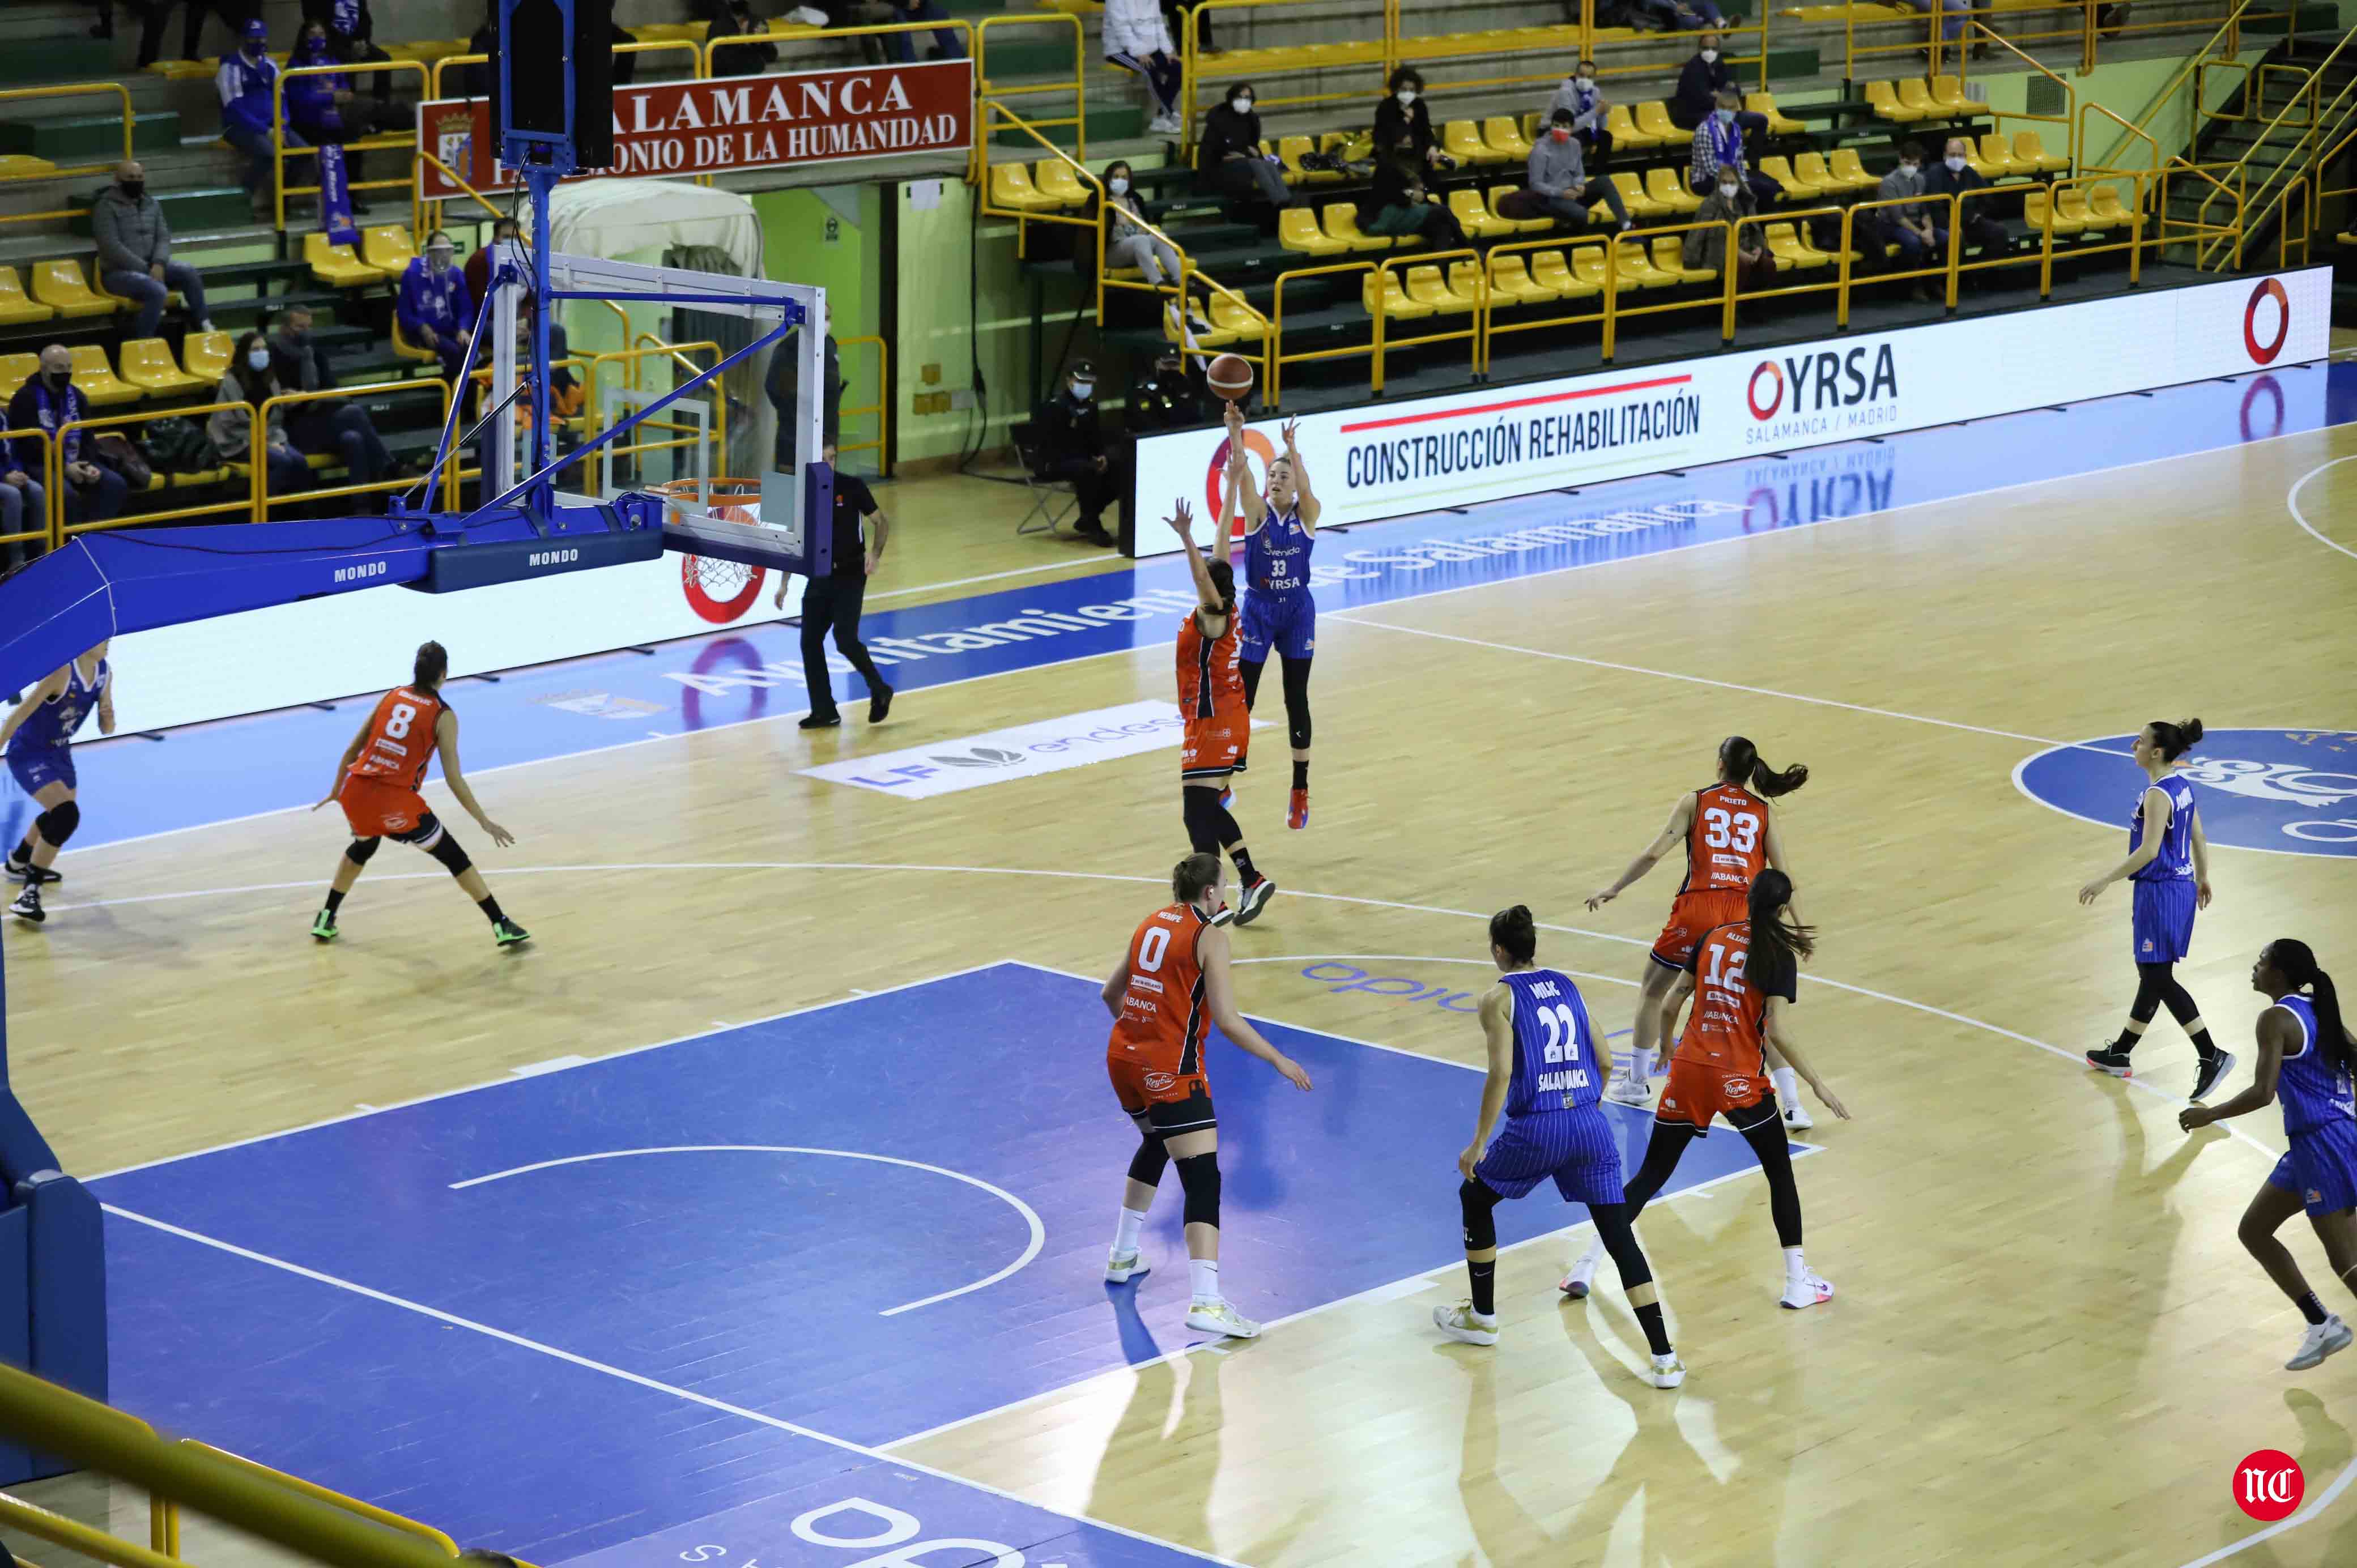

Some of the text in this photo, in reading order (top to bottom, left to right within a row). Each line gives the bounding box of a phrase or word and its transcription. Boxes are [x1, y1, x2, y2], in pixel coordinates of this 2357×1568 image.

[614, 74, 913, 135] LAMANCA
[694, 134, 734, 167] DE
[743, 130, 779, 163] LA
[788, 114, 957, 158] HUMANIDAD
[1347, 388, 1700, 489] CONSTRUCCIÓN REHABILITACIÓN
[1746, 418, 1827, 445] SALAMANCA
[1847, 404, 1897, 429] MADRID
[334, 561, 386, 583] MONDO
[529, 548, 578, 566] MONDO
[1271, 560, 1286, 577] 33
[385, 703, 416, 739] 8
[1029, 715, 1183, 754] endes
[1720, 795, 1747, 806] PRIETO
[1704, 807, 1759, 853] 33
[2181, 811, 2189, 859] 1
[1158, 911, 1183, 923] HEMPE
[1138, 926, 1171, 973] 0
[1727, 932, 1750, 944] ALIAG
[1704, 943, 1749, 995] 12
[1537, 1003, 1579, 1064] 22
[1538, 1069, 1589, 1093] SALAMANCA
